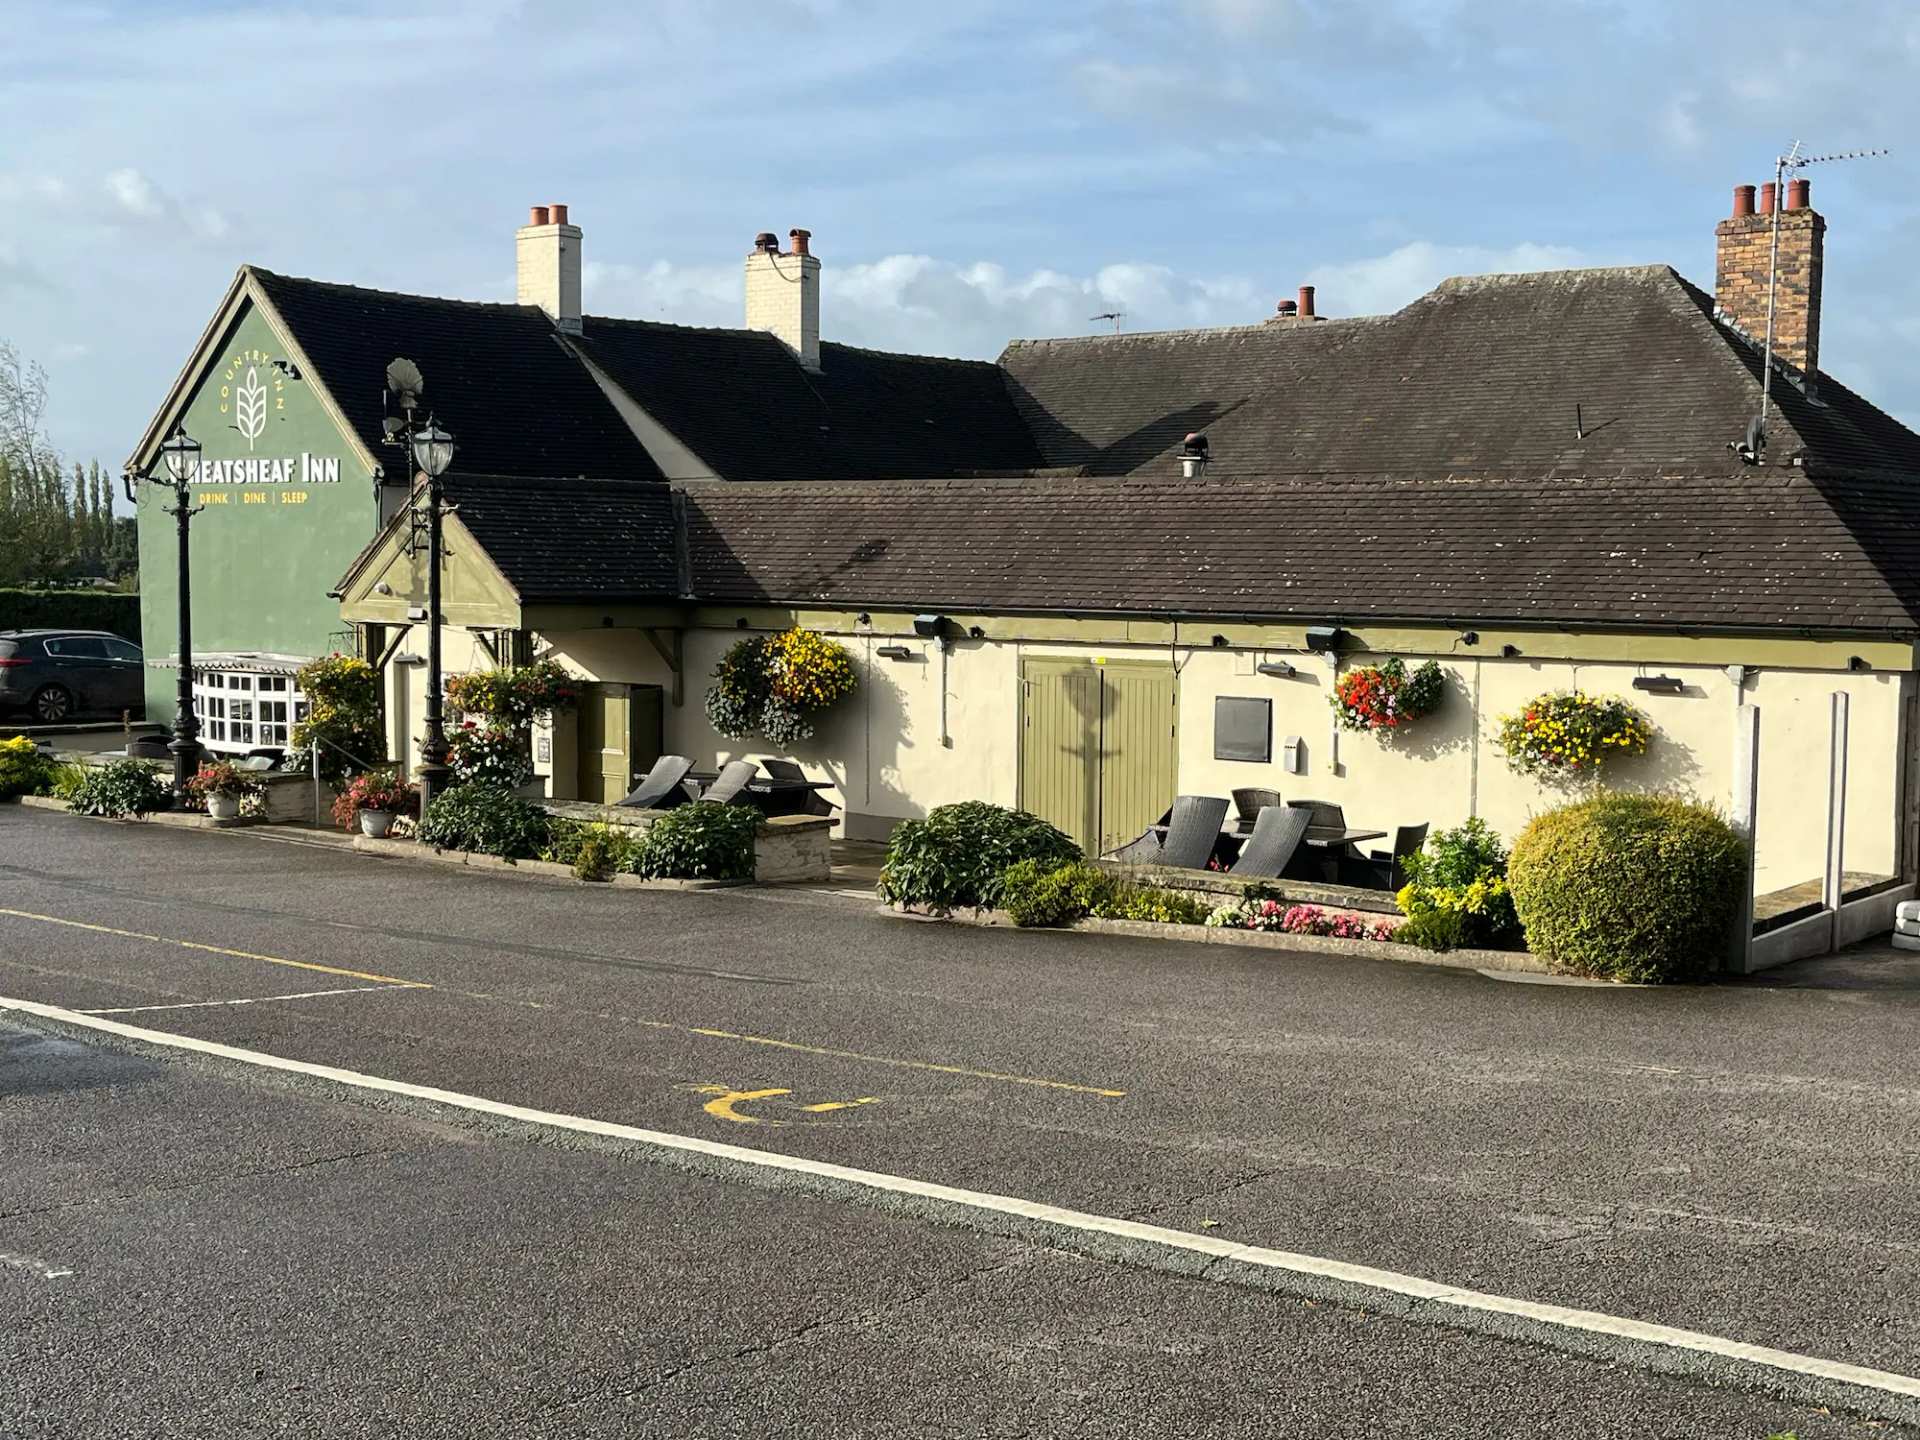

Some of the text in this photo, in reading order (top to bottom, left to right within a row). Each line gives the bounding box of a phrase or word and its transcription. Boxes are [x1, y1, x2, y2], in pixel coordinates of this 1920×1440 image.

[220, 349, 284, 413] COUNTRY INN
[199, 491, 308, 504] DRINK DINE SLEEP
